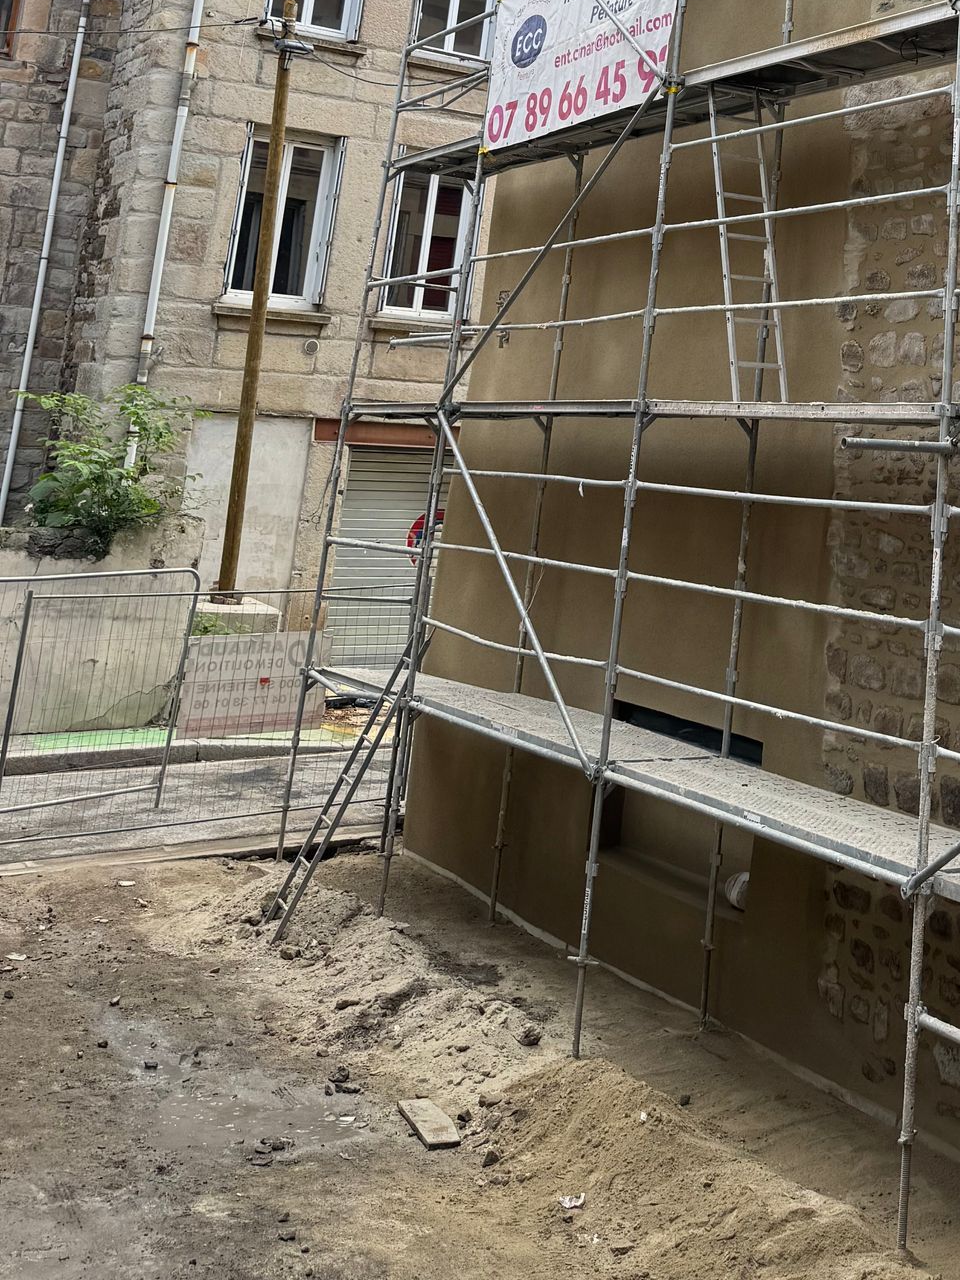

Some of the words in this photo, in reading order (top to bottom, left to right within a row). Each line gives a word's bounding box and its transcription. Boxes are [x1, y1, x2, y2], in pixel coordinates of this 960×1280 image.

[515, 28, 543, 57] ECC
[487, 100, 518, 143] 07
[525, 87, 551, 132] 89
[558, 75, 588, 120] 66
[595, 59, 627, 105] 45
[638, 45, 667, 93] 9
